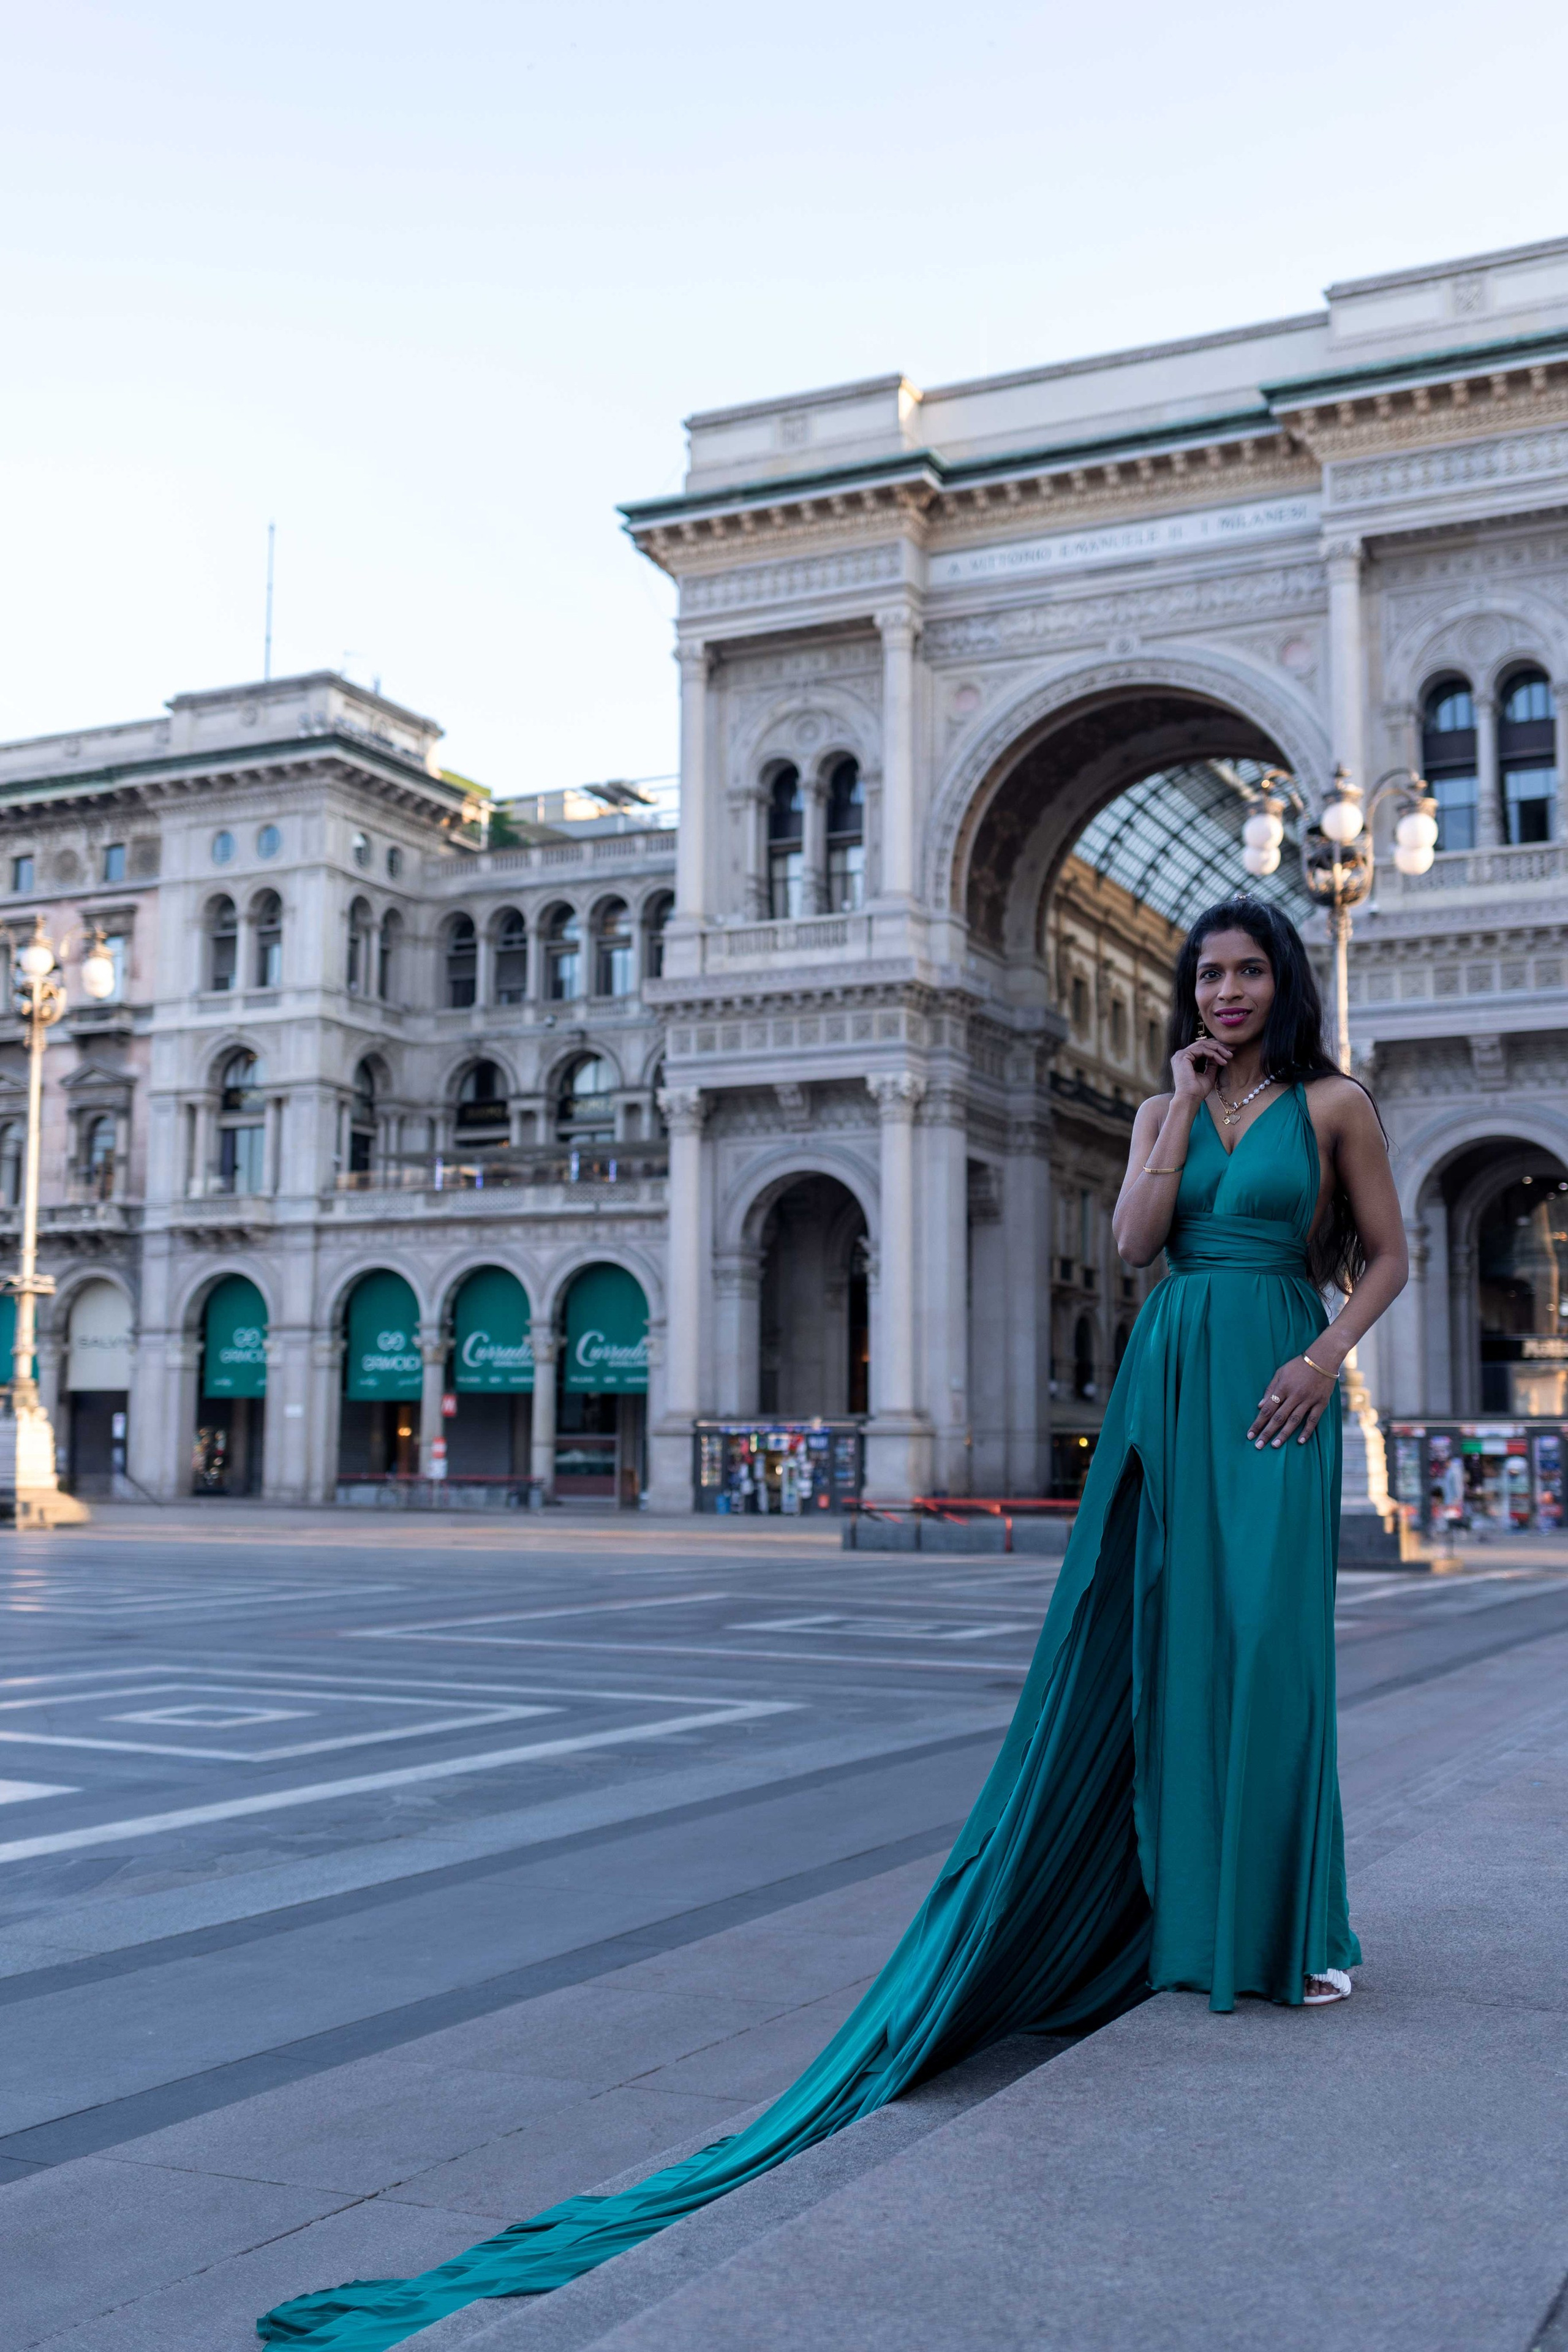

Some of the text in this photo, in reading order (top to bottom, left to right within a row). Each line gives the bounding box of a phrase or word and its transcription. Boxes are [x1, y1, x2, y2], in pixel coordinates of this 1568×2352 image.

[948, 560, 962, 576] A
[969, 545, 1052, 573] VITTORIO
[1059, 527, 1160, 558] EMANUELE
